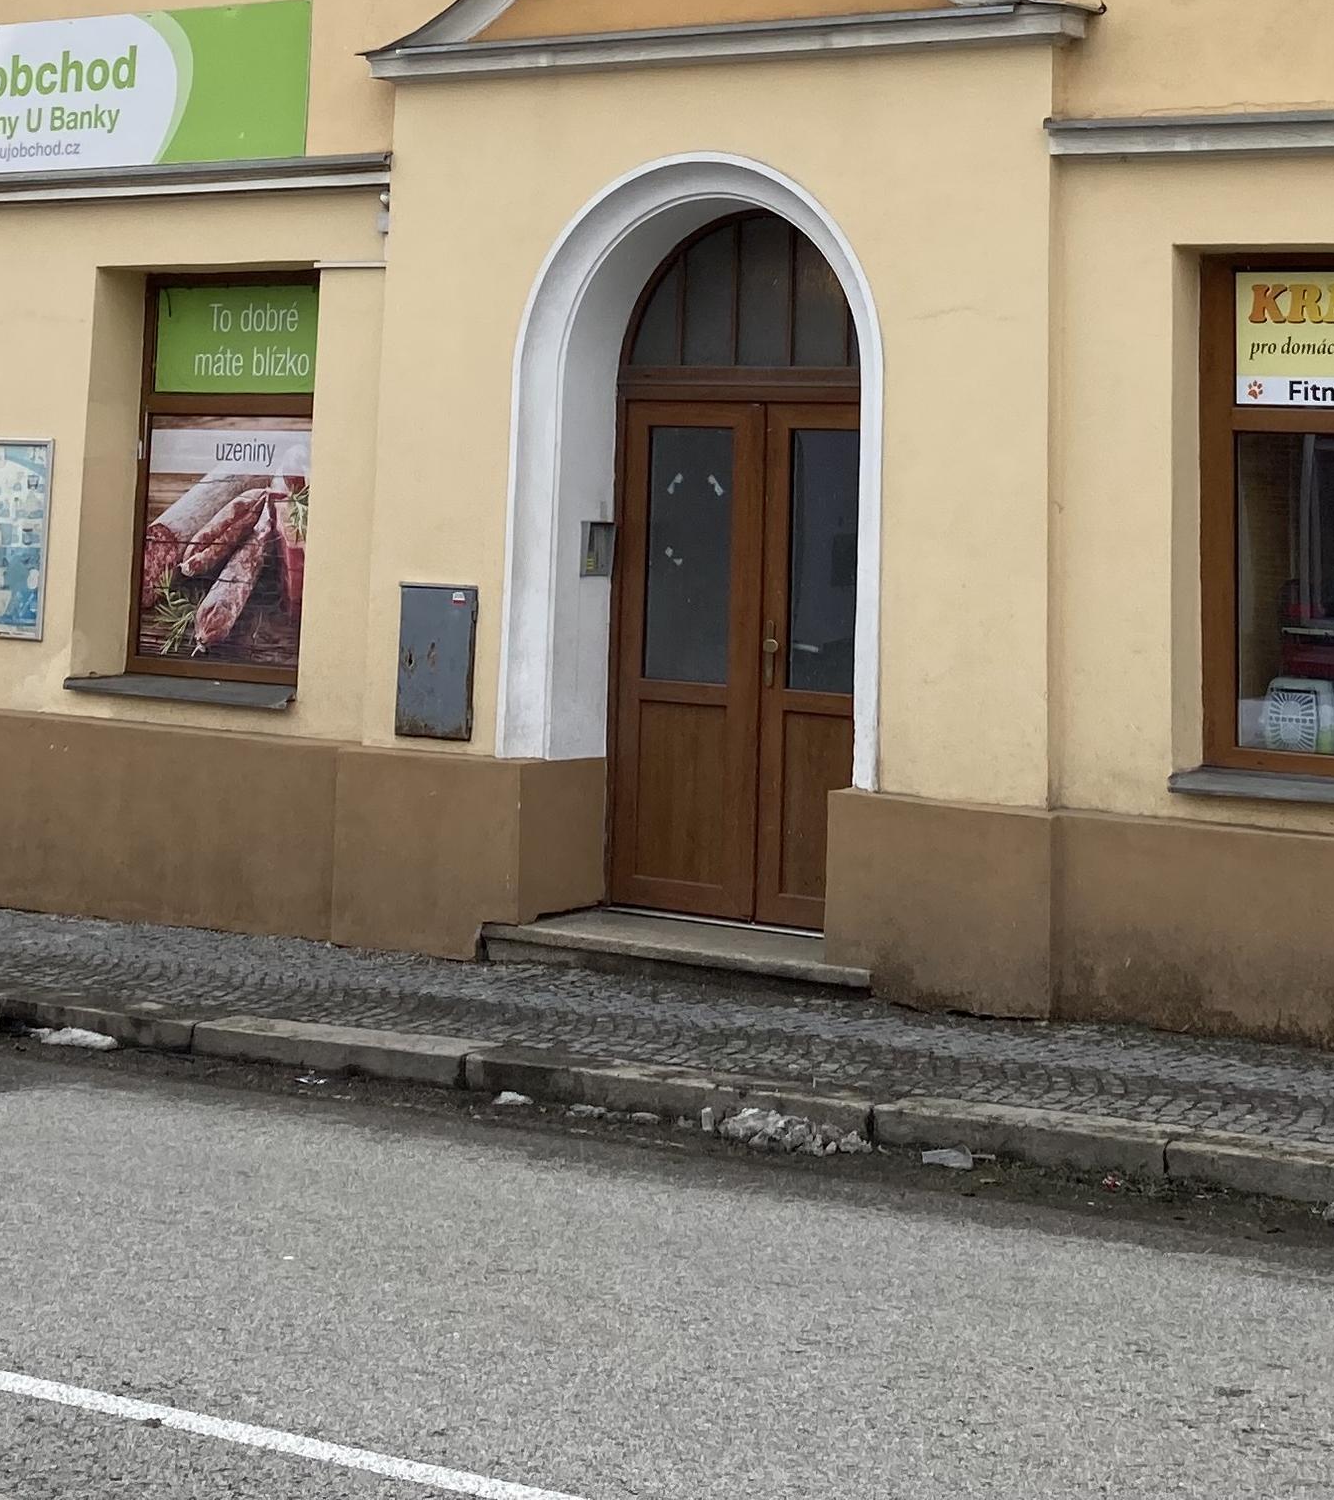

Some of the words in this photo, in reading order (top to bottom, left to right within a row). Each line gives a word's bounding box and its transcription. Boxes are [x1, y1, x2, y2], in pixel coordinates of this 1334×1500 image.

[26, 107, 43, 133] U
[49, 104, 121, 134] Banky
[209, 303, 232, 332] To
[240, 301, 300, 333] dobré
[194, 346, 244, 377] máte
[252, 346, 310, 377] blízko
[1249, 341, 1277, 361] pro
[215, 438, 276, 468] uzeniny
